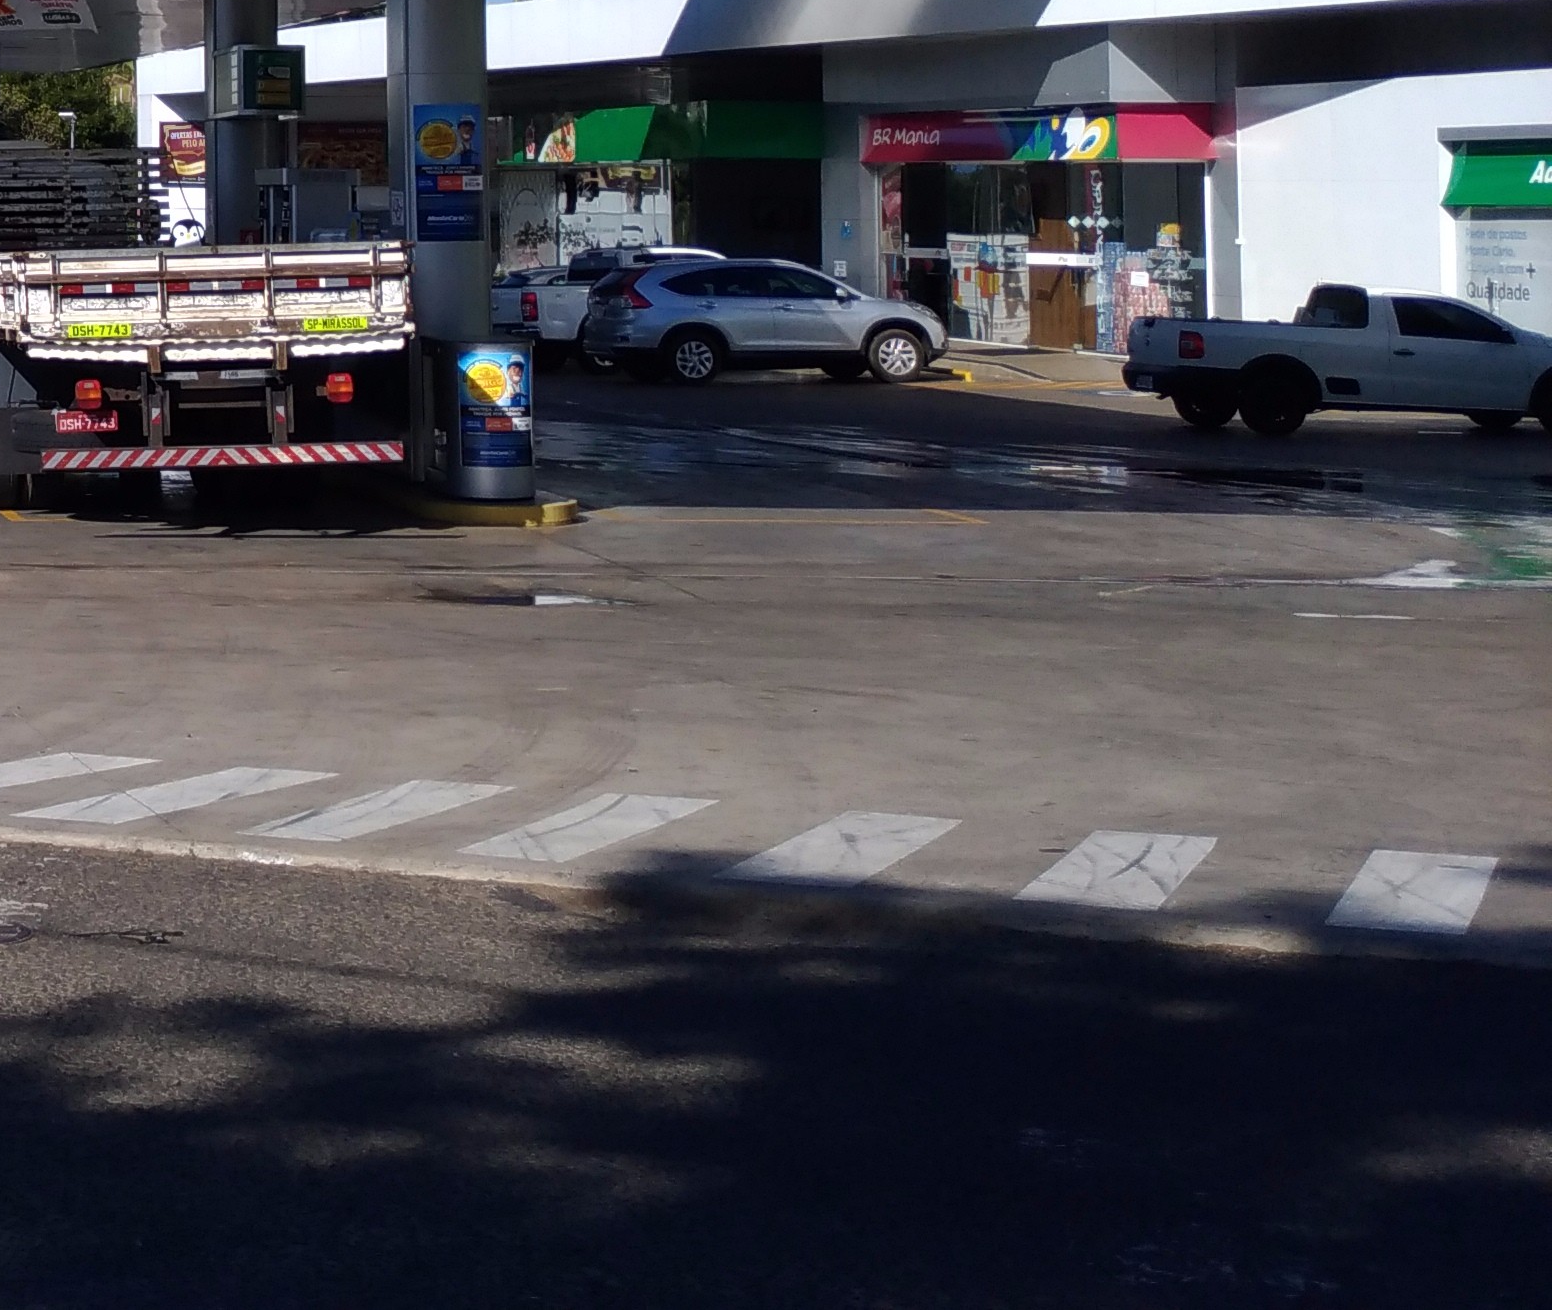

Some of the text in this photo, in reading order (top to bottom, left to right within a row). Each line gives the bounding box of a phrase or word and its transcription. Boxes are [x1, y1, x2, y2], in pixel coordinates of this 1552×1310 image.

[872, 125, 940, 146] BR Mania
[1467, 281, 1530, 301] Qualidade
[307, 317, 364, 330] SP-MIRASSOL
[72, 324, 129, 337] DSH-7743
[59, 418, 116, 431] DSH-7743
